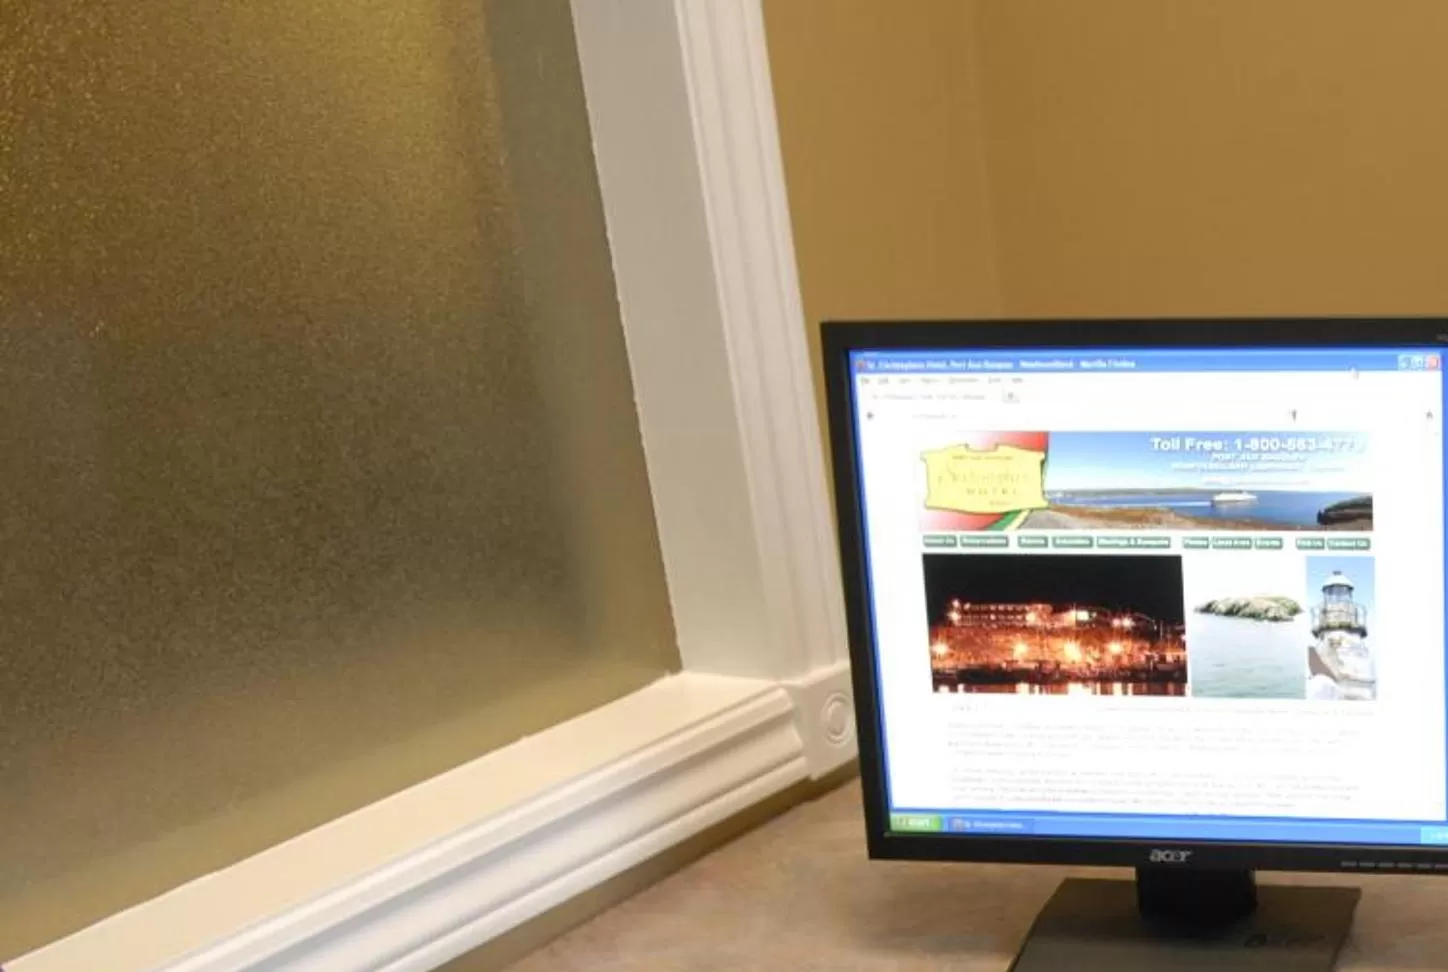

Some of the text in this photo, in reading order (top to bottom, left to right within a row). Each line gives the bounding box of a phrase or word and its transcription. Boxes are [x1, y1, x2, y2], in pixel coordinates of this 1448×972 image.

[1150, 437, 1180, 452] Toll
[1185, 437, 1229, 452] Free:
[1149, 849, 1192, 862] acer
